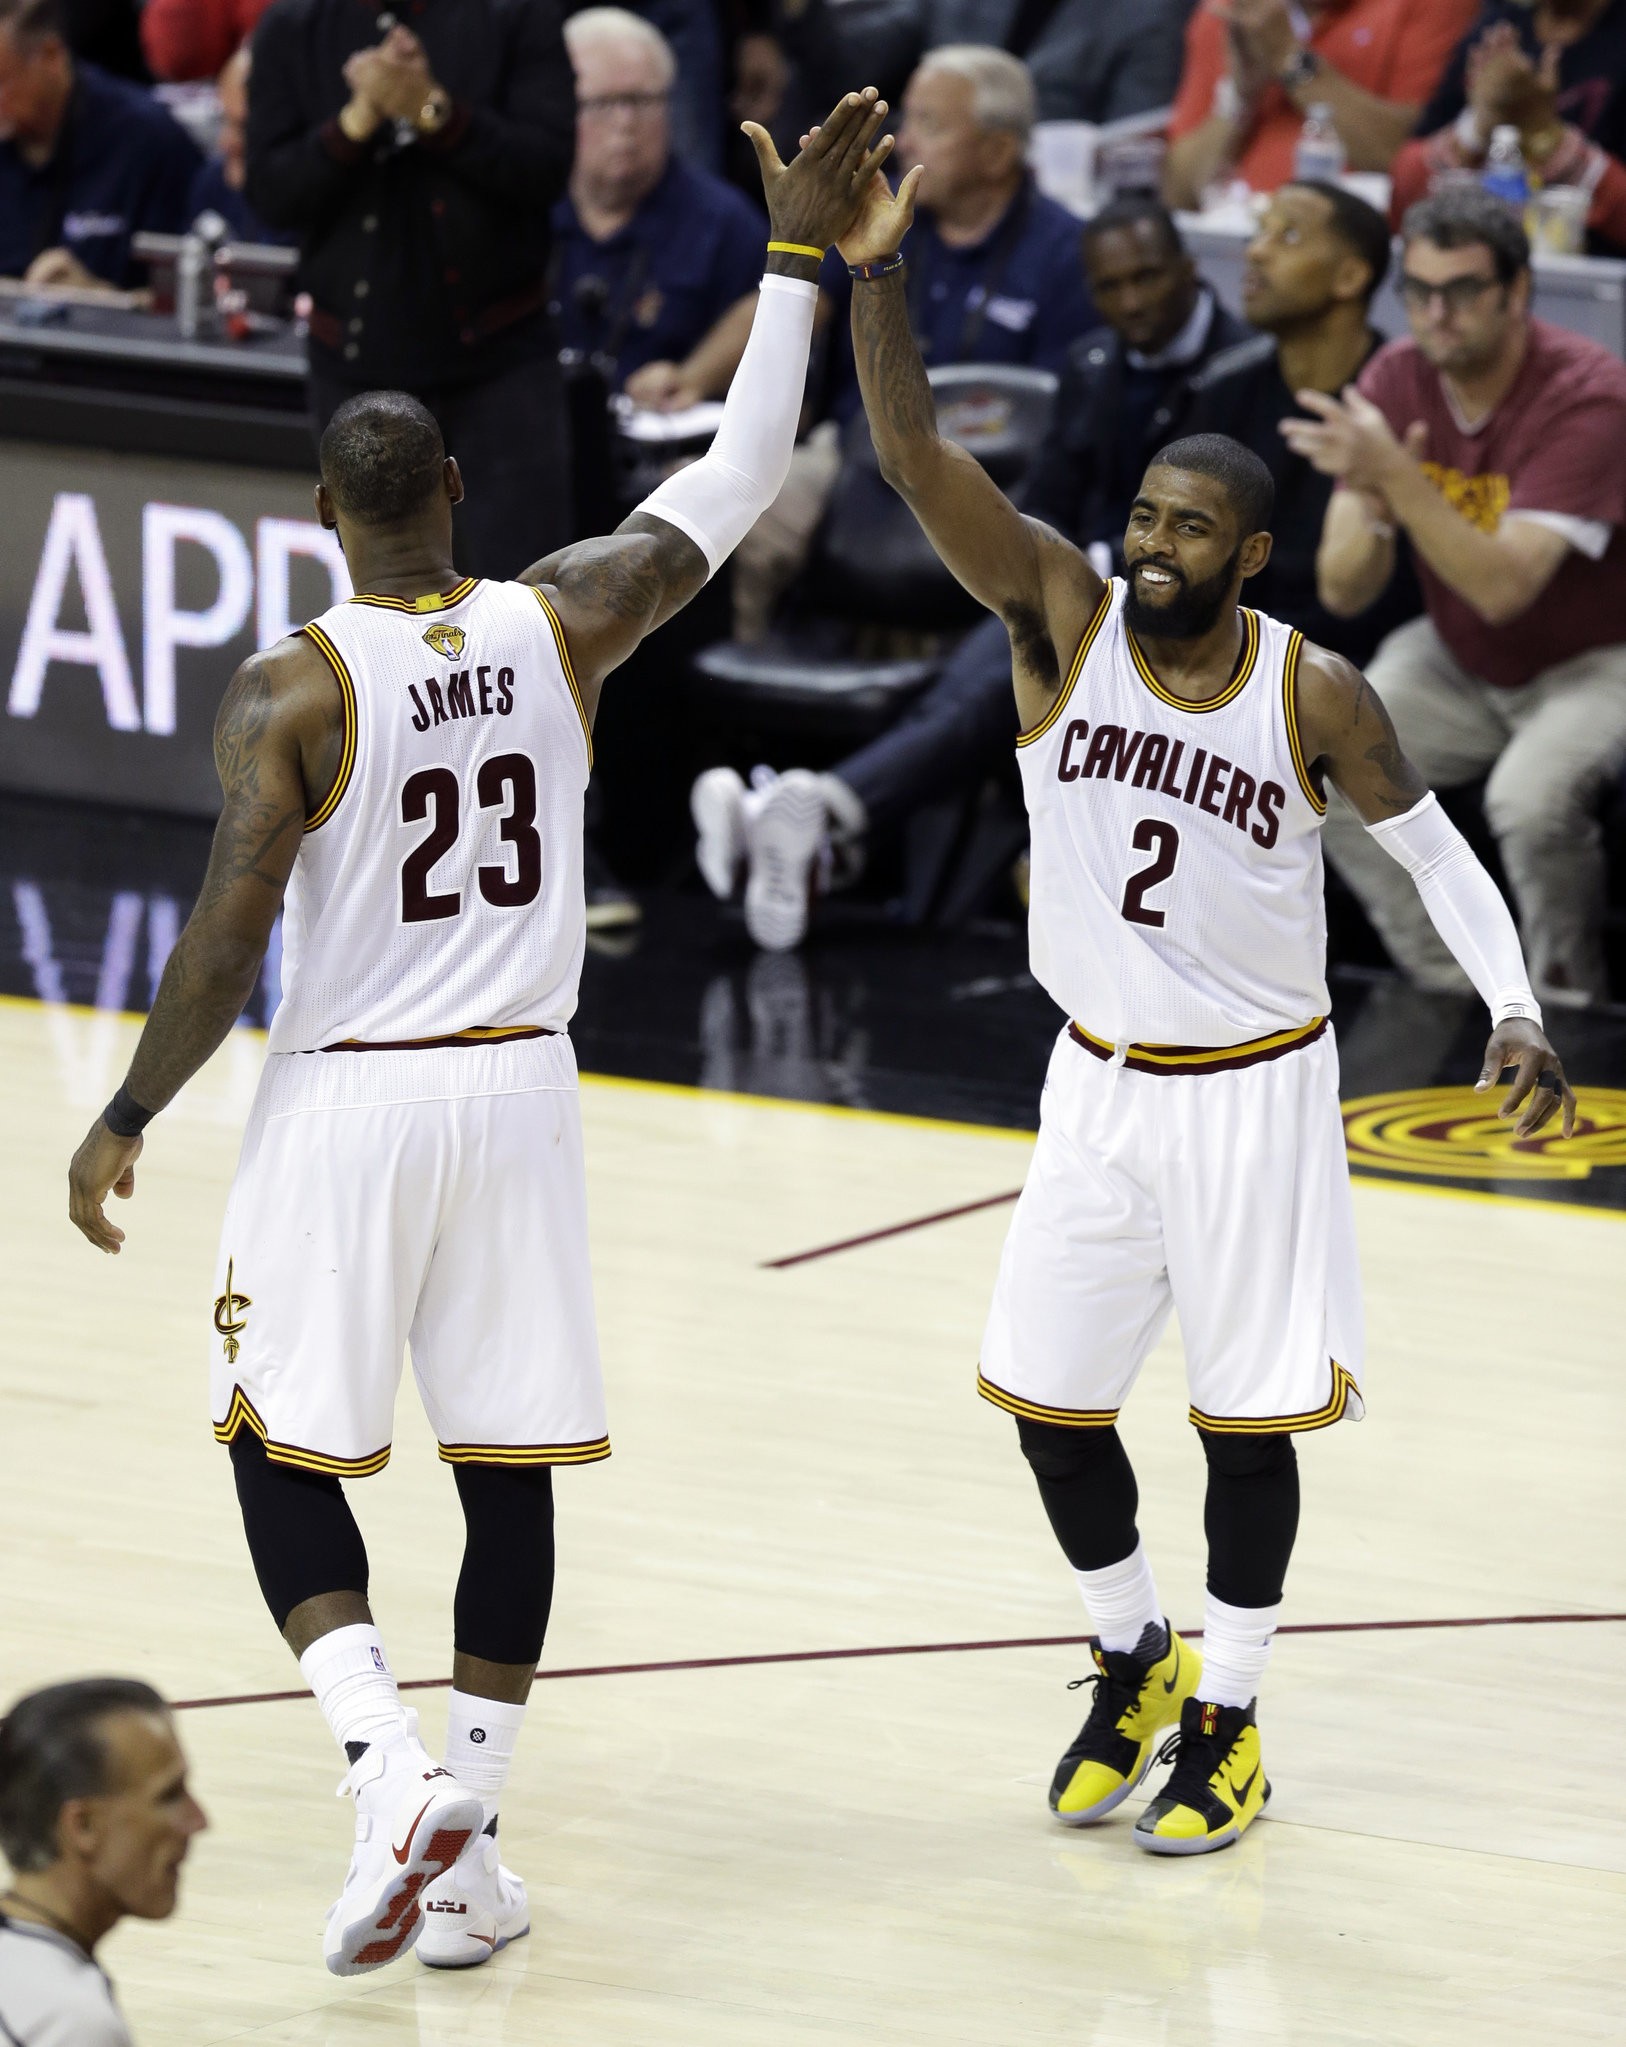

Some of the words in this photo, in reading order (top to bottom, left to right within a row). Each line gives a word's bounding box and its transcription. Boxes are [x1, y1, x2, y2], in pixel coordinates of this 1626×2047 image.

[408, 666, 515, 732] JAMES
[401, 753, 542, 923] 23
[1058, 719, 1286, 850] CAVALIERS
[1121, 818, 1180, 928] 2
